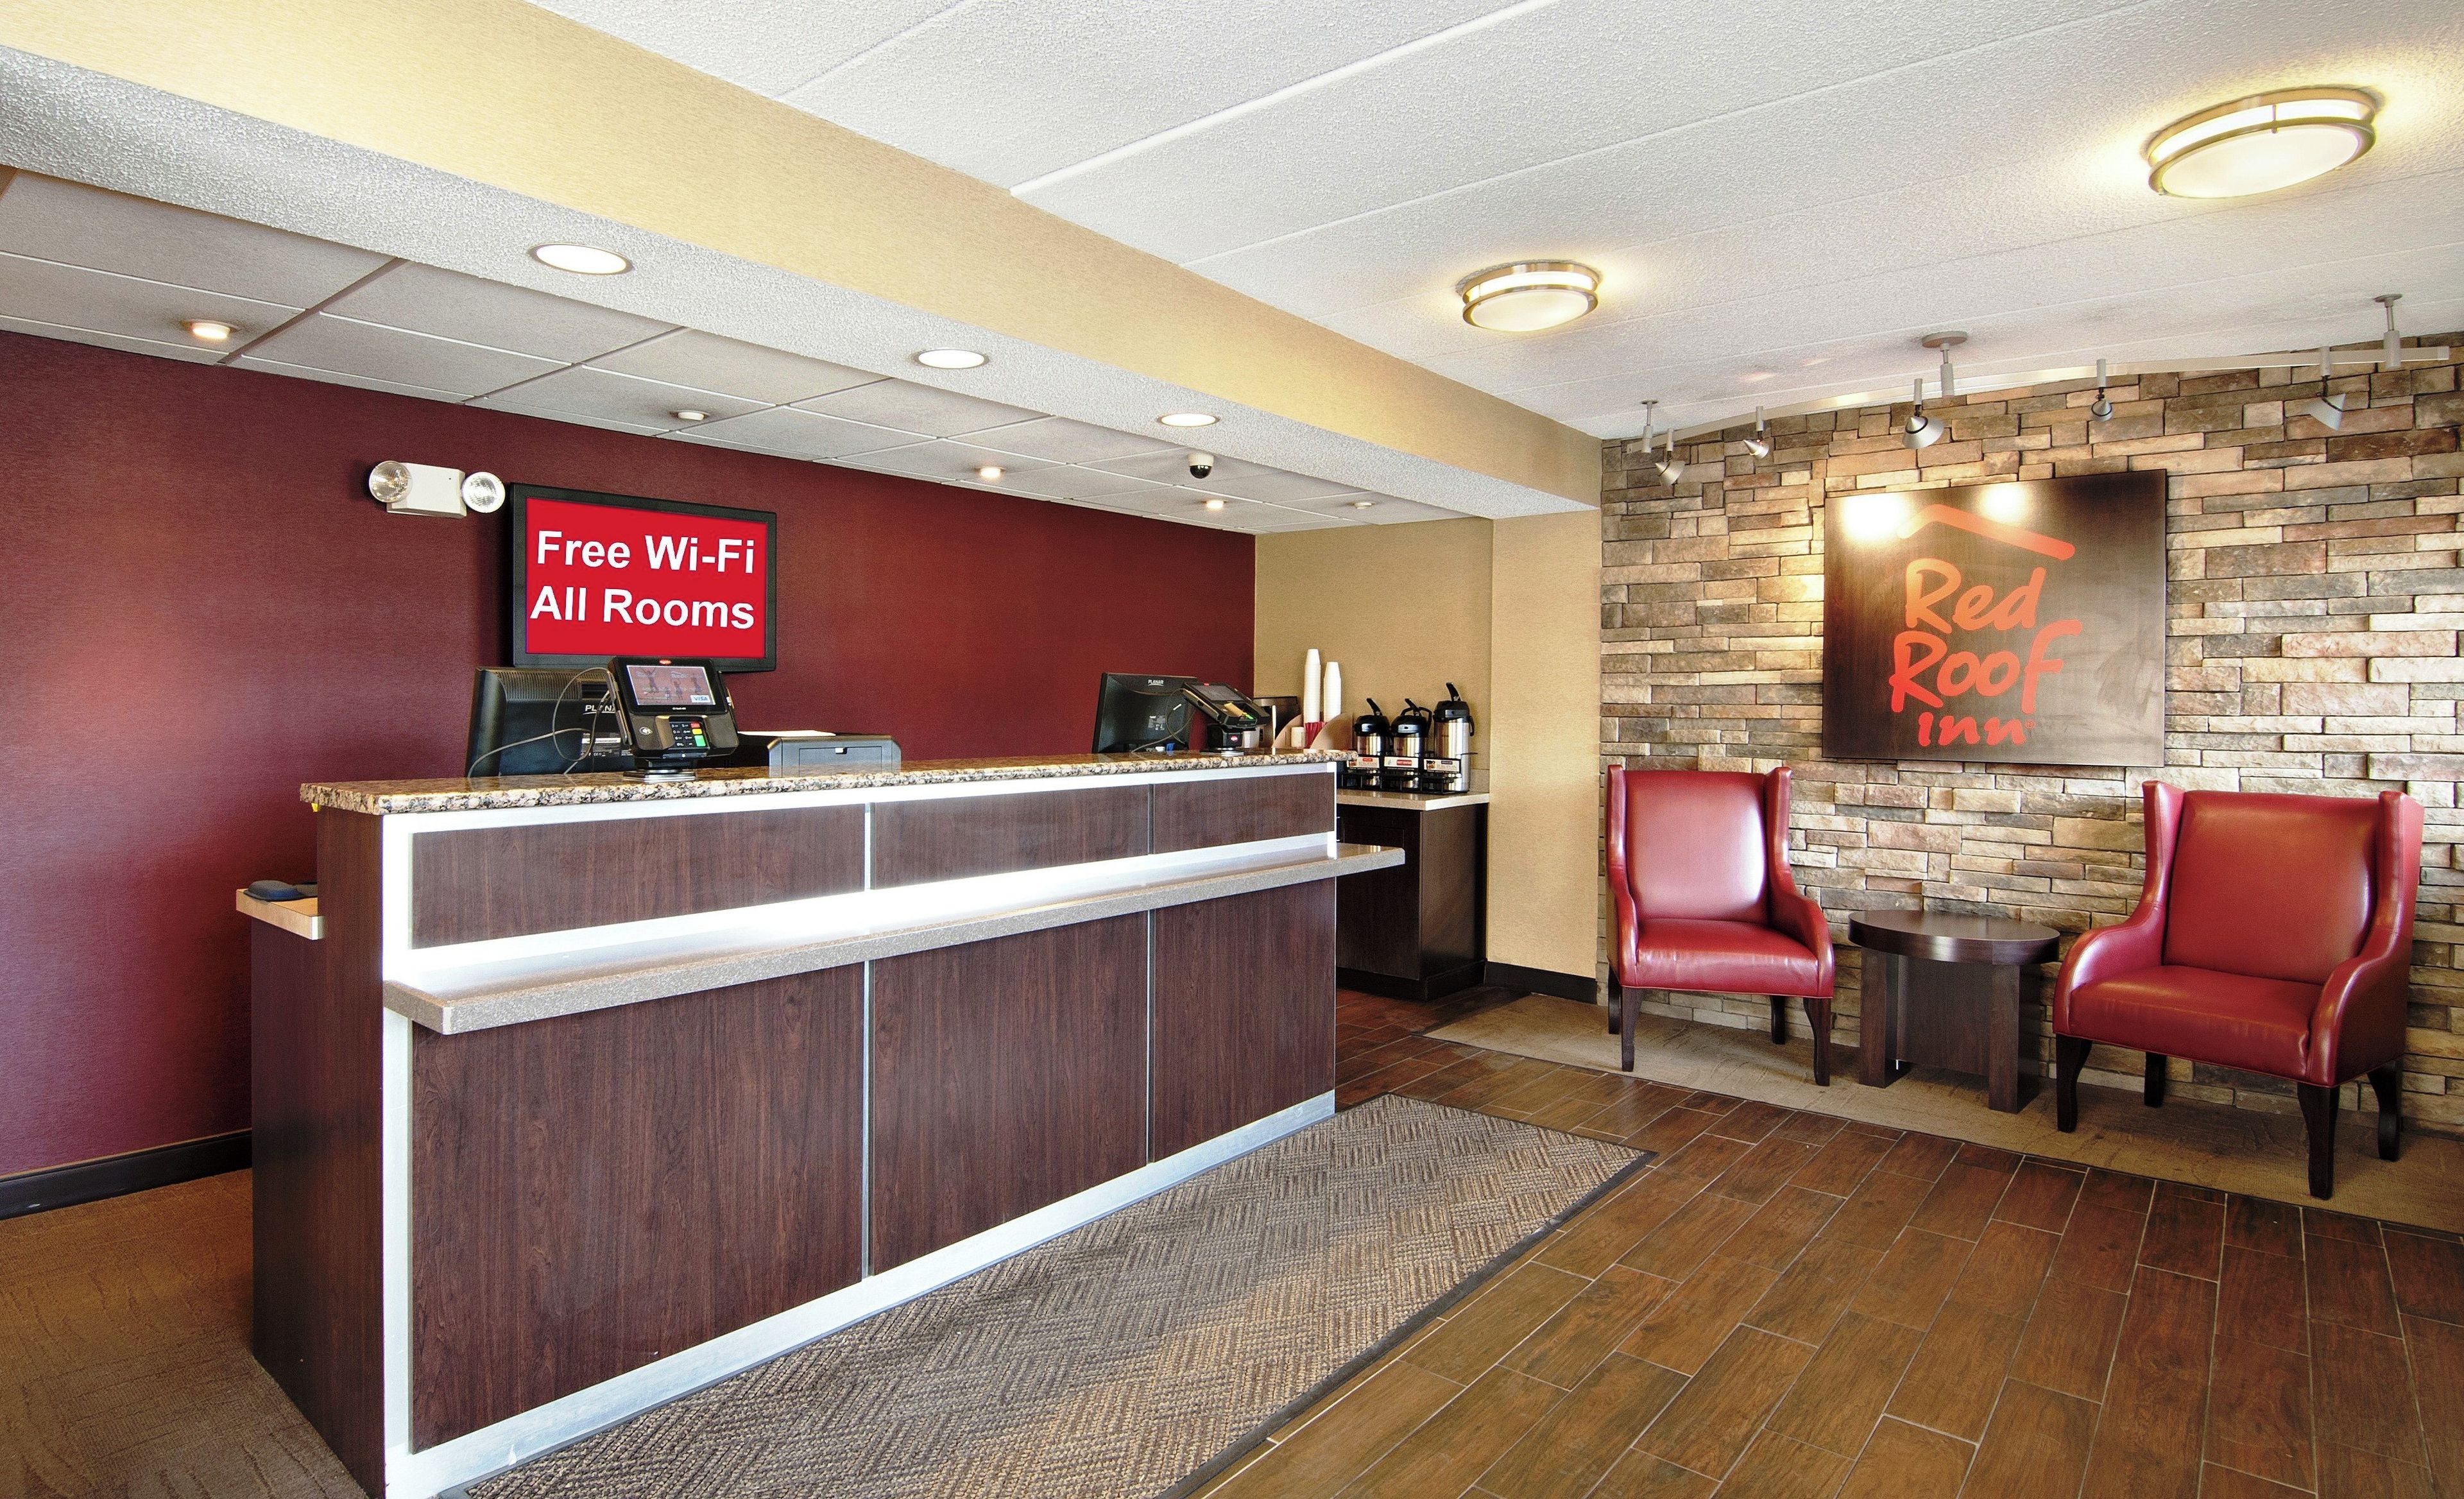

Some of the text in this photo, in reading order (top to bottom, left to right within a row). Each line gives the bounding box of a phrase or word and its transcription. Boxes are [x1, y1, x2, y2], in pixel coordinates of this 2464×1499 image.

[537, 530, 755, 574] Free Wi-Fi
[530, 585, 755, 630] All Rooms
[1904, 558, 2047, 634] Red
[1888, 619, 2083, 714] Roof
